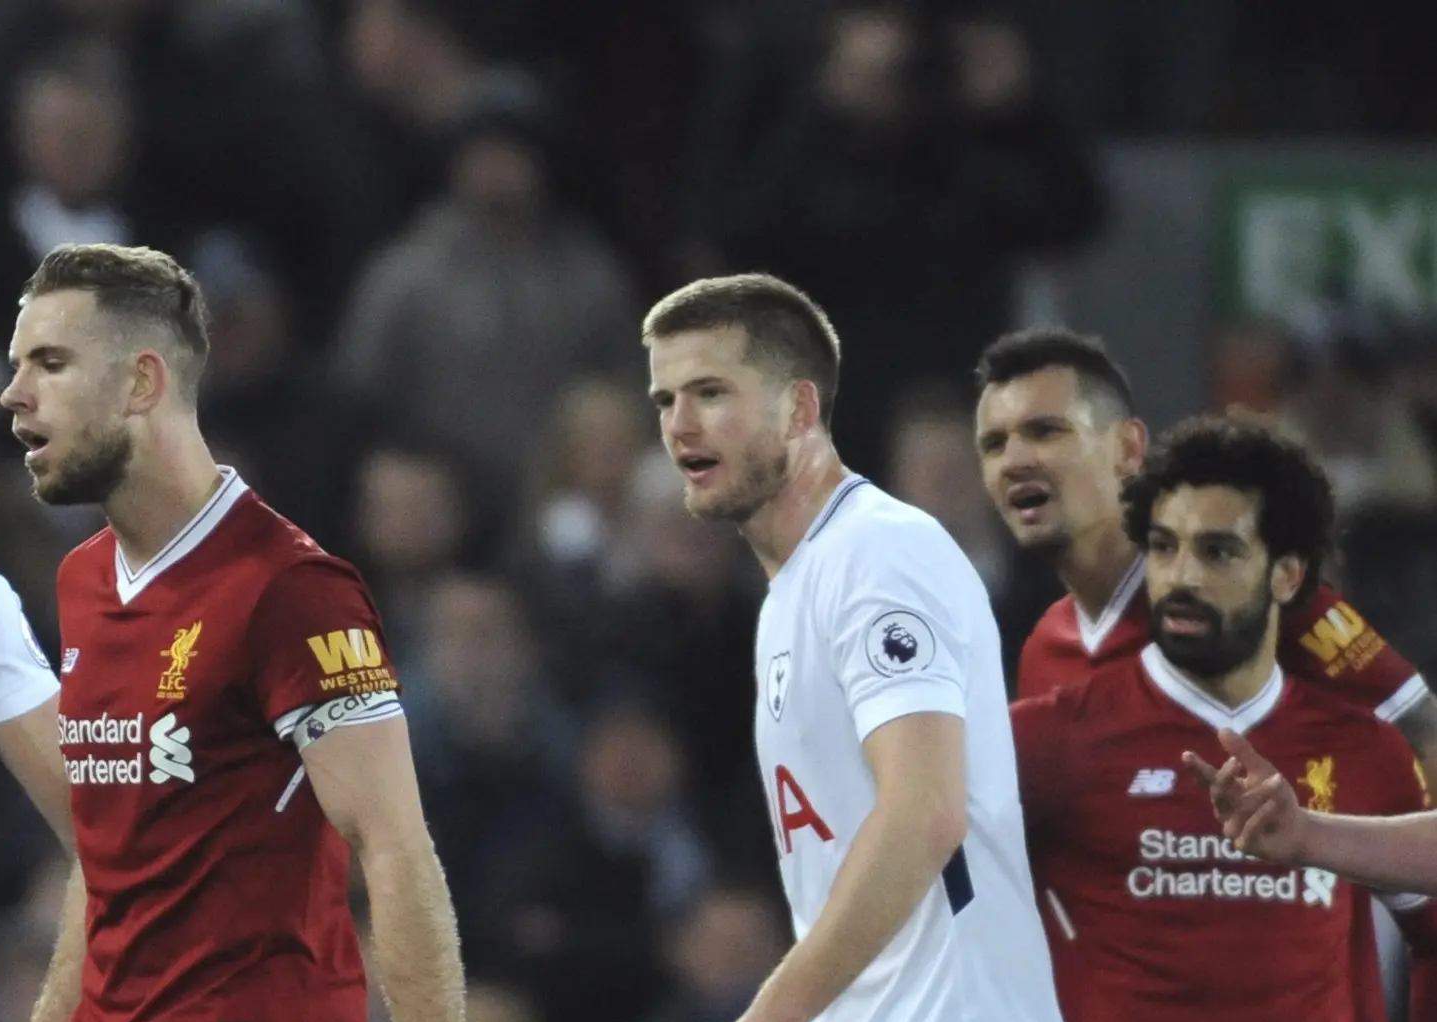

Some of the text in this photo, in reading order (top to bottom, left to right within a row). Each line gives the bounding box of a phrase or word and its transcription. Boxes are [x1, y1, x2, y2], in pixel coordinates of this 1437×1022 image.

[1239, 196, 1437, 316] EX
[307, 628, 382, 675] WU
[320, 668, 391, 692] WESTERN
[328, 690, 384, 721] Cap
[63, 752, 142, 784] hartered
[1128, 865, 1297, 901] Chartered
